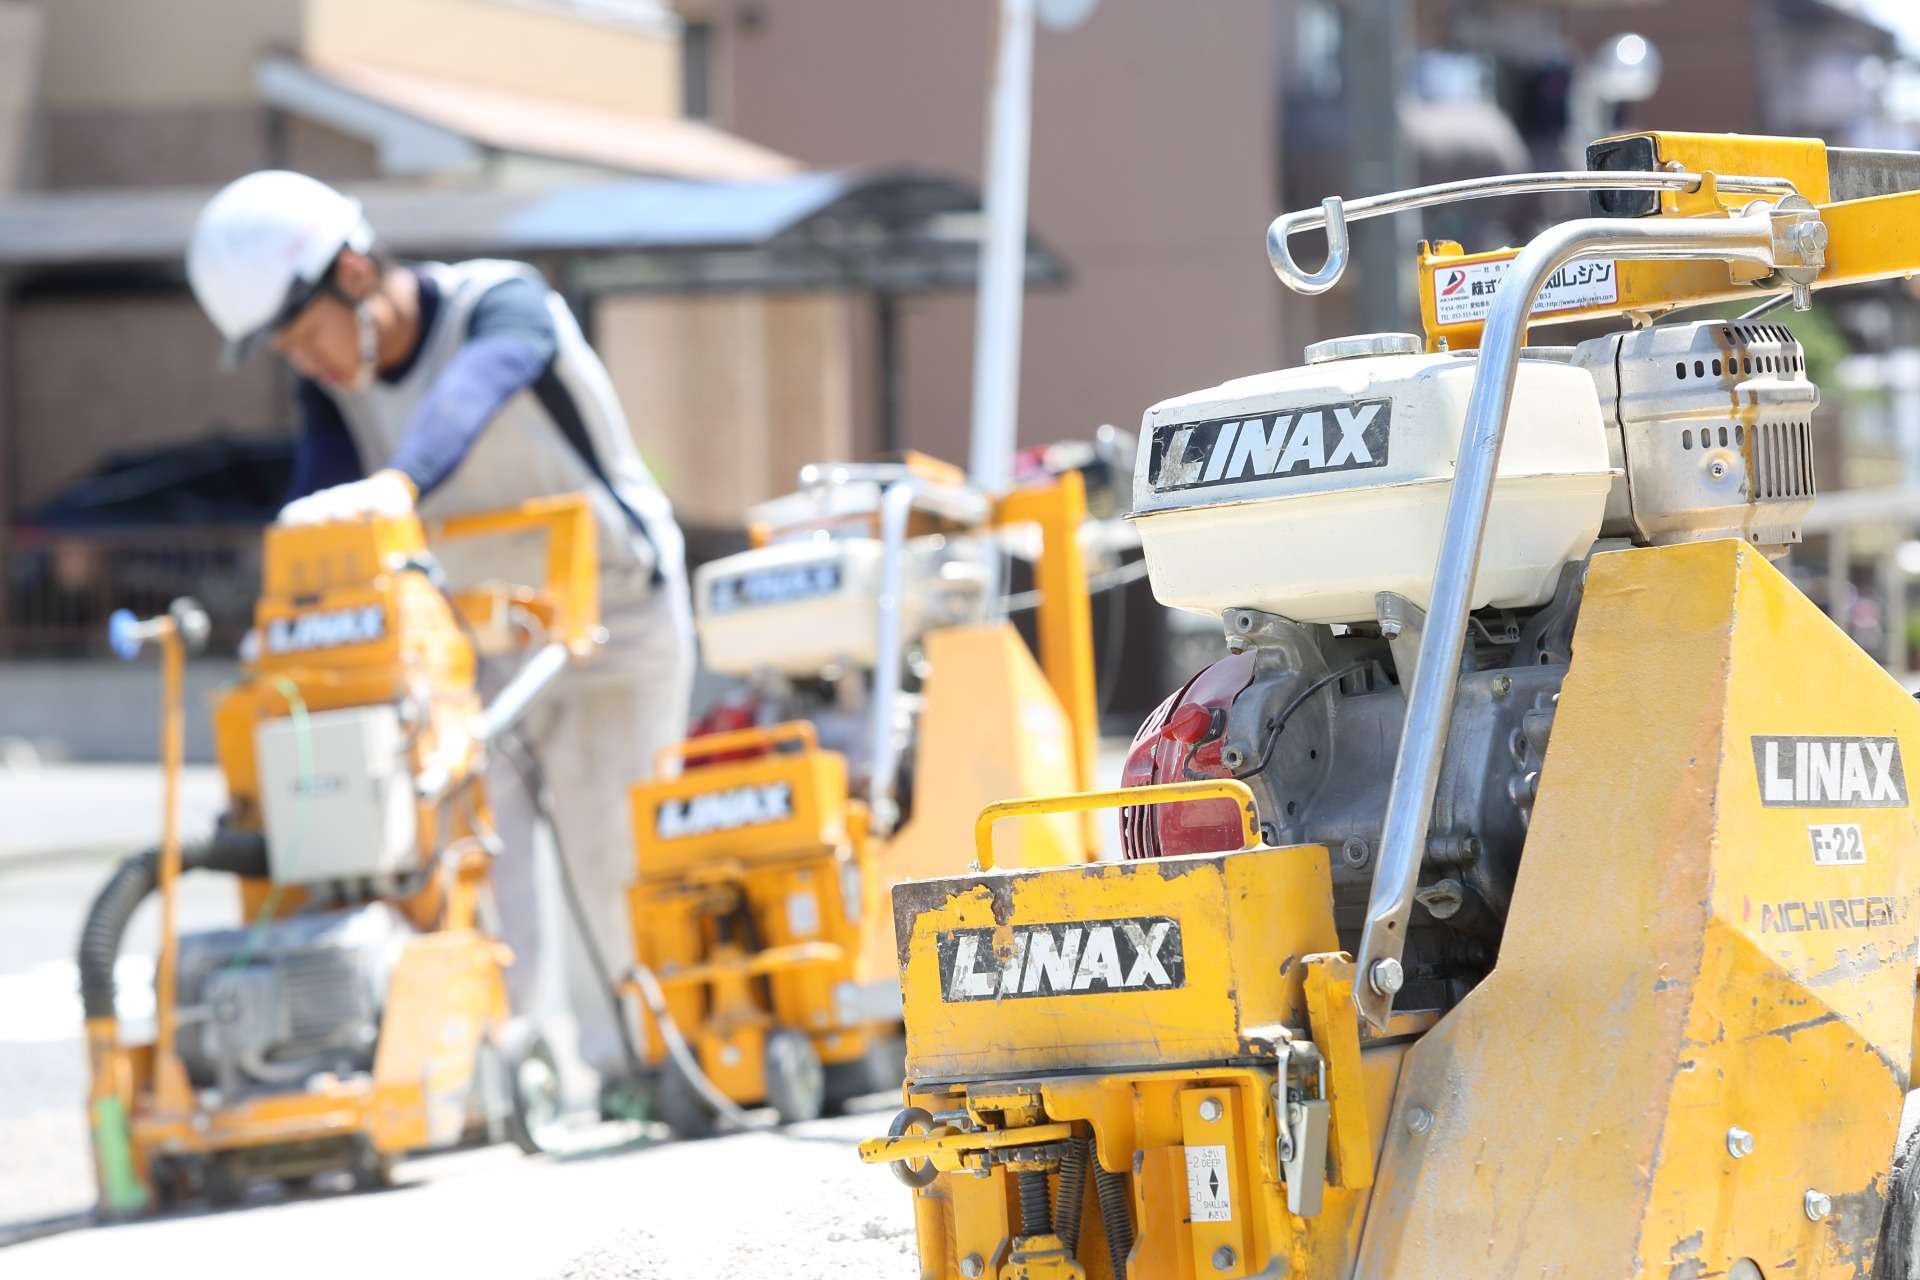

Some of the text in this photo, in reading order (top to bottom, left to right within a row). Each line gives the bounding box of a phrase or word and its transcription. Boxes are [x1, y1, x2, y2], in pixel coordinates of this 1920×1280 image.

[1471, 278, 1503, 296] 株式
[1156, 404, 1383, 488] LINAX
[1765, 742, 1901, 800] LINAX
[1810, 827, 1864, 861] F-22
[949, 922, 1172, 998] LINAX
[1201, 1159, 1221, 1168] DEEP
[1203, 1200, 1229, 1208] SHALLOW
